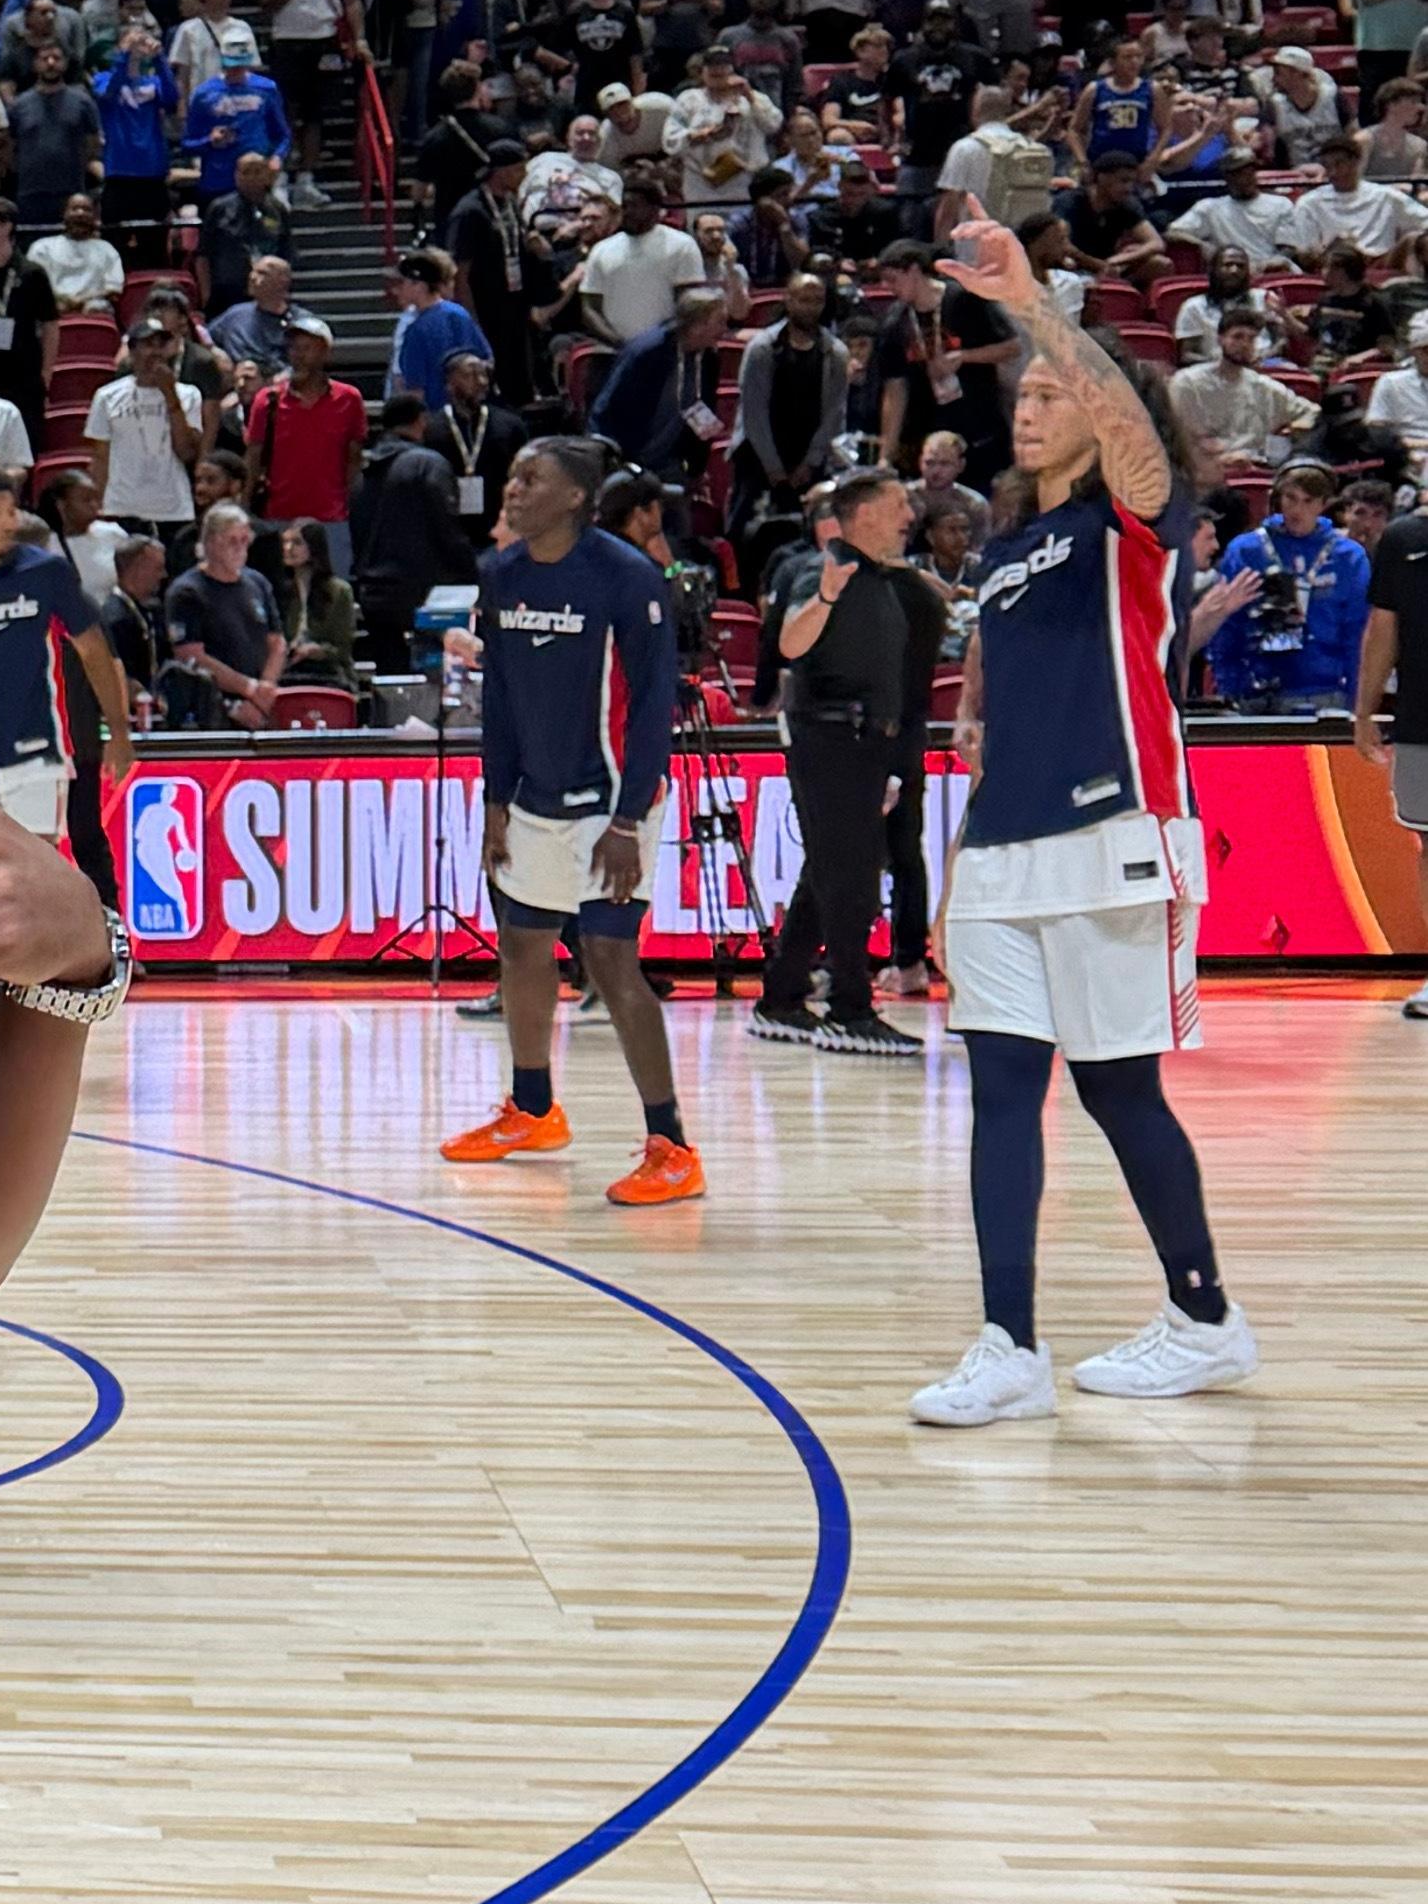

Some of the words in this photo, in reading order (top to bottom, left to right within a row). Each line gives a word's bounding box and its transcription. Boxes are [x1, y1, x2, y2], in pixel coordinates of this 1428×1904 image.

[1107, 106, 1139, 130] 30
[498, 601, 586, 634] wizards
[222, 776, 497, 934] SUMM
